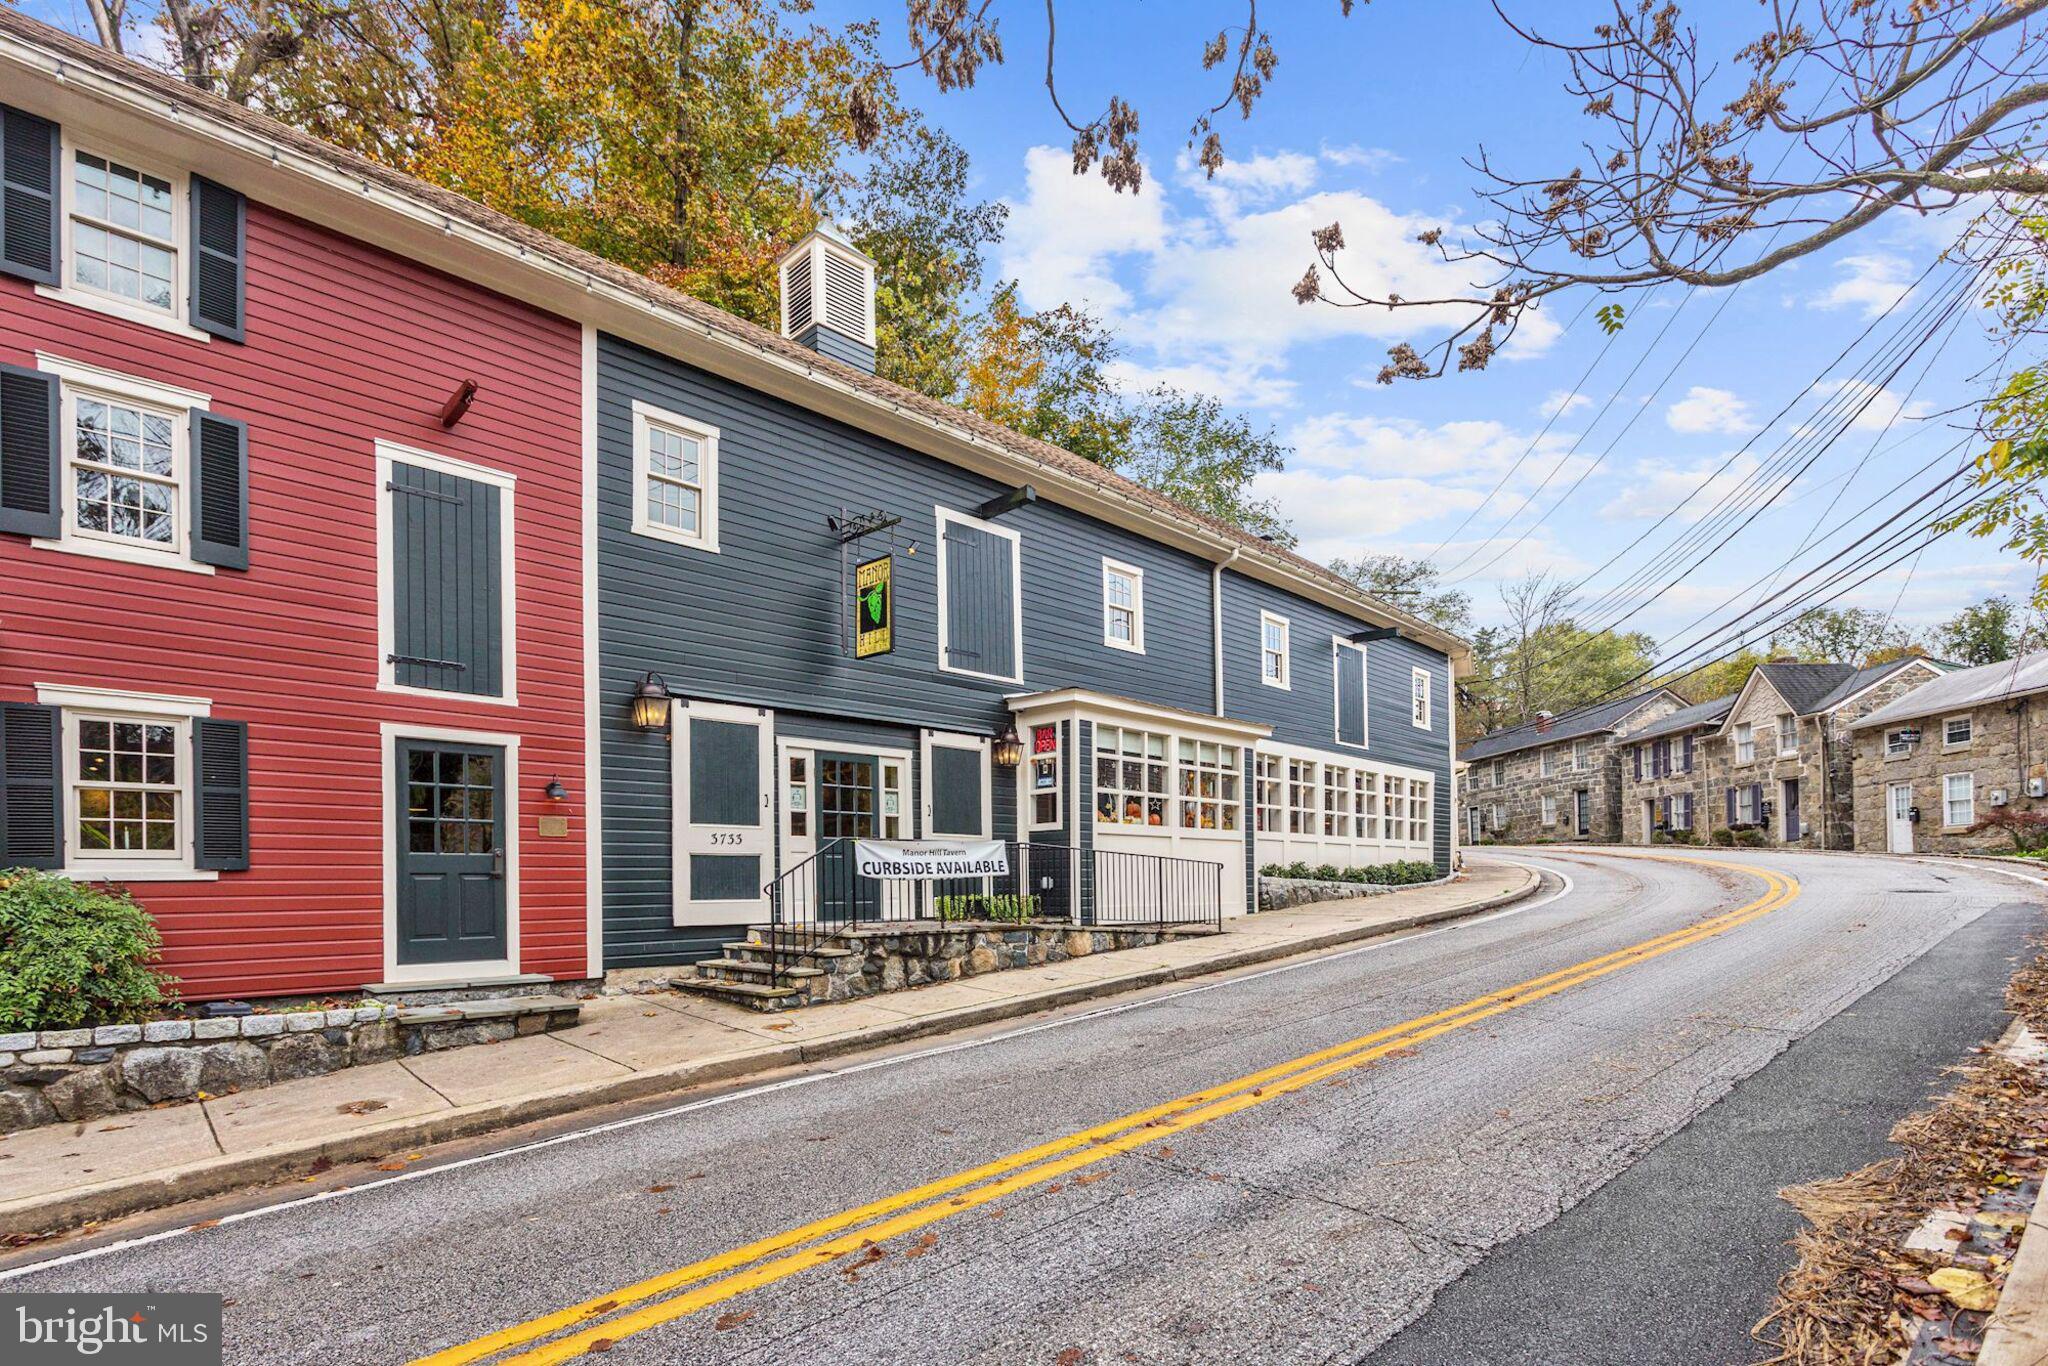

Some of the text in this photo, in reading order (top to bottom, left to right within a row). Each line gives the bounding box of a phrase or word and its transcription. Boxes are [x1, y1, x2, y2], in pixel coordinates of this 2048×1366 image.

[858, 562, 889, 588] MANOR
[1036, 727, 1054, 740] BAR
[1035, 739, 1056, 753] OPEN
[711, 833, 742, 845] 3733
[862, 860, 1005, 875] CURBSIDE AVAILABLE
